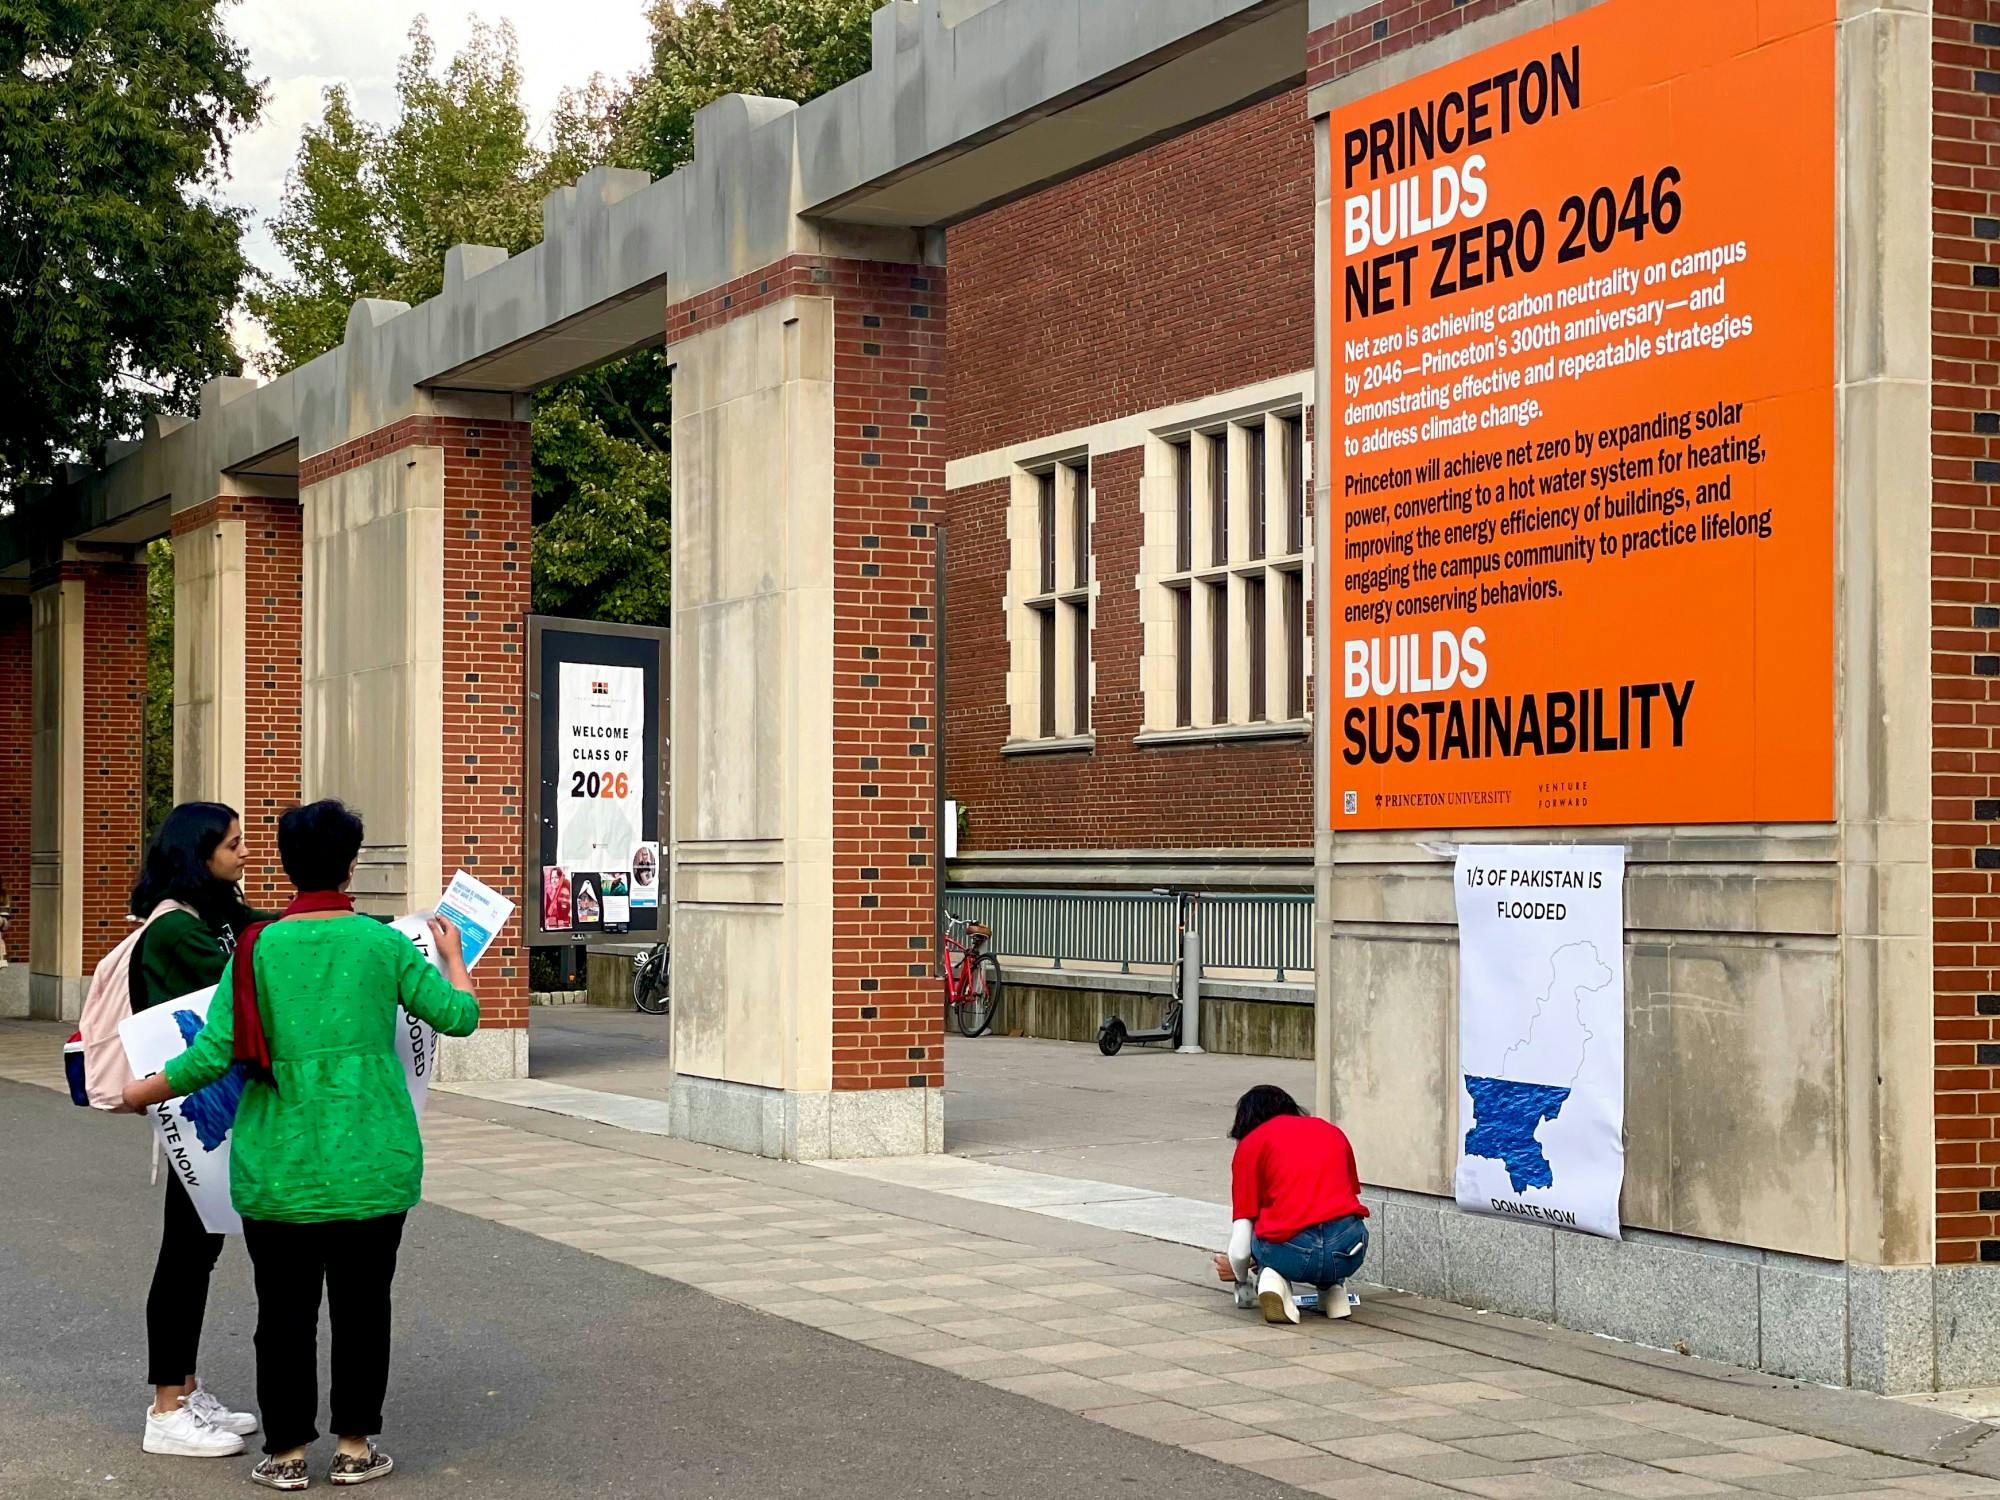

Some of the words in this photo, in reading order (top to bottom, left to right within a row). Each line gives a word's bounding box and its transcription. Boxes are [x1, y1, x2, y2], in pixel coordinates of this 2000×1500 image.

[1344, 45, 1580, 189] PRINCETON
[1344, 154, 1488, 257] BUILDS
[1344, 245, 1419, 322] NET
[1430, 207, 1545, 299] ZERO
[1557, 165, 1682, 264] 2046
[1345, 337, 1370, 363] Net
[1372, 333, 1402, 356] zero
[1406, 324, 1418, 348] is
[1422, 305, 1495, 342] achieving
[1498, 293, 1553, 323] carbon
[1557, 267, 1640, 308] neutrality
[1644, 262, 1666, 285] on
[1671, 241, 1746, 278] campus
[1344, 372, 1362, 397] by
[1510, 320, 1560, 354] 300th
[1344, 383, 1450, 426] demonstrating
[1453, 367, 1521, 401] effective
[1524, 356, 1554, 385] and
[1559, 335, 1651, 380] repeatable
[1655, 315, 1752, 355] strategies
[1344, 436, 1359, 457] to
[1362, 426, 1418, 453] address
[1421, 410, 1477, 441] climate
[1480, 398, 1543, 428] change.
[1345, 468, 1411, 496] Princeton
[1416, 458, 1439, 483] will
[1444, 451, 1502, 478] achieve
[1507, 441, 1532, 466] net
[1537, 438, 1570, 461] zero
[1575, 430, 1594, 458] by
[1598, 411, 1691, 451] expanding
[1696, 401, 1743, 430] solar
[1345, 506, 1389, 533] power,
[1394, 488, 1472, 519] converting
[1475, 484, 1491, 506] to
[1496, 485, 1504, 502] a
[1509, 475, 1535, 500] hot
[1539, 468, 1586, 494] water
[1591, 458, 1653, 490] system
[1658, 449, 1682, 474] for
[1688, 434, 1765, 469] heating,
[1345, 531, 1413, 562] improving
[1416, 526, 1440, 548] the
[1445, 519, 1496, 544] energy
[1501, 506, 1579, 535] efficiency
[1584, 496, 1600, 522] of
[1605, 487, 1690, 519] buildings,
[1696, 474, 1730, 504] and
[1345, 564, 1410, 594] engaging
[1413, 559, 1436, 581] the
[1441, 553, 1500, 579] campus
[1504, 535, 1595, 569] community
[1600, 532, 1617, 555] to
[1622, 521, 1696, 558] practice
[1702, 509, 1772, 540] lifelong
[1345, 600, 1392, 624] energy
[1396, 587, 1477, 616] conserving
[1481, 577, 1562, 606] behaviors.
[1344, 626, 1488, 699] BUILDS
[572, 725, 629, 739] WELCOME
[573, 748, 610, 760] CLASS
[615, 749, 629, 761] OF
[1343, 680, 1696, 766] SUSTAINABILITY
[571, 770, 629, 799] 2026
[1385, 792, 1446, 808] PRINCETON
[1448, 790, 1512, 806] UNIVERSITY
[1538, 781, 1589, 793] VENTURE
[1538, 797, 1589, 809] FORWARD
[1467, 866, 1484, 888] 1/3
[1488, 869, 1507, 886] OF
[1510, 870, 1584, 888] PAKISTAN
[1589, 871, 1602, 889] IS
[1497, 901, 1567, 921] FLOODED
[405, 1010, 425, 1077] OODED
[172, 1147, 200, 1187] NOW
[1491, 1198, 1543, 1219] DONATE
[1543, 1207, 1577, 1225] NOW
